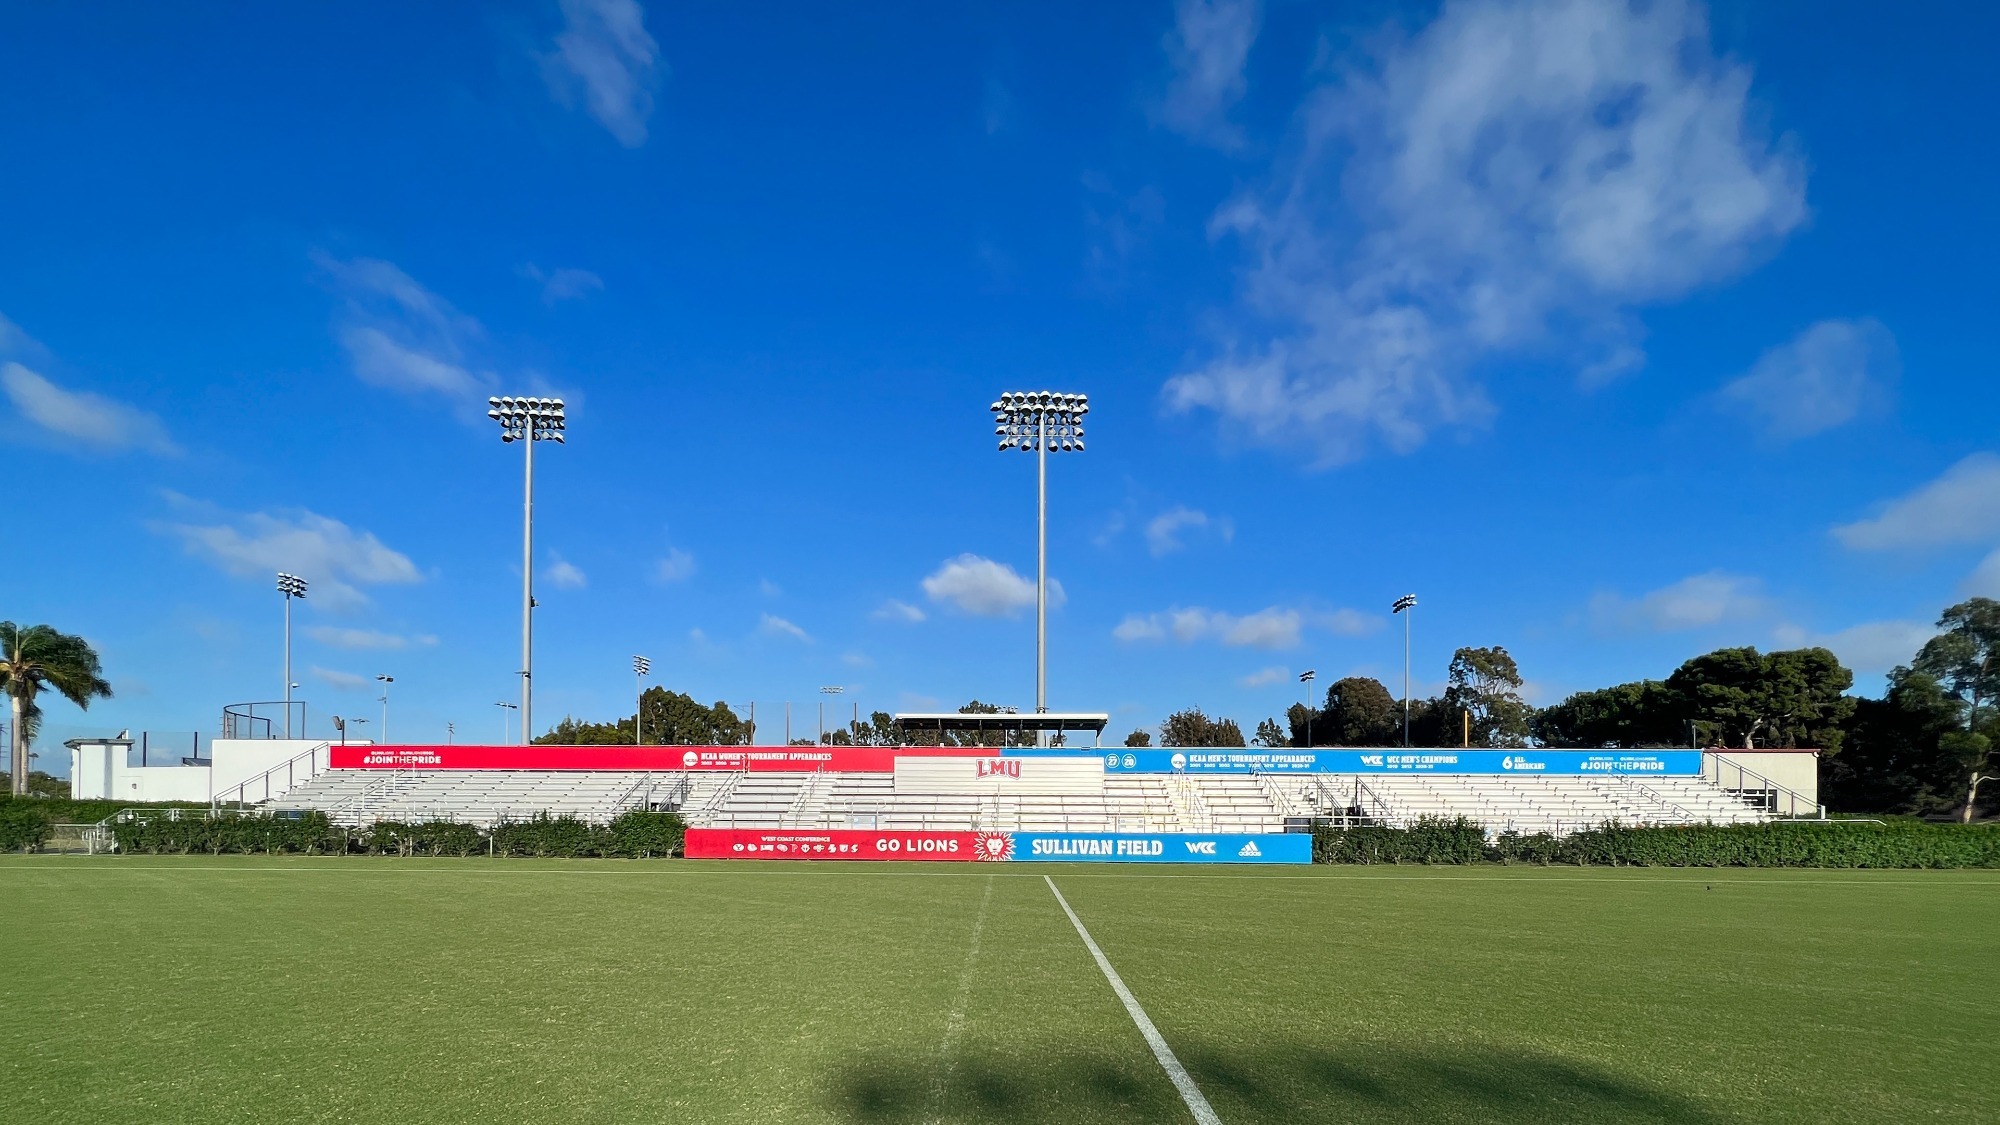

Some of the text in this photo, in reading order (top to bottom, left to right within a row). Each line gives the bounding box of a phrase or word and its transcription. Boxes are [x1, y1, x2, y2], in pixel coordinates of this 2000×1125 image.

[363, 756, 441, 764] #JOINTHEPRIDE
[1124, 758, 1134, 766] 20
[1360, 756, 1384, 765] WCC
[1502, 756, 1513, 770] 6
[1581, 762, 1665, 770] #JOINTHEPRIDE
[976, 759, 1022, 780] LMU
[876, 839, 958, 852] GO LIONS
[1031, 839, 1163, 856] SULLIVAN FIELD
[1184, 841, 1216, 854] WCC
